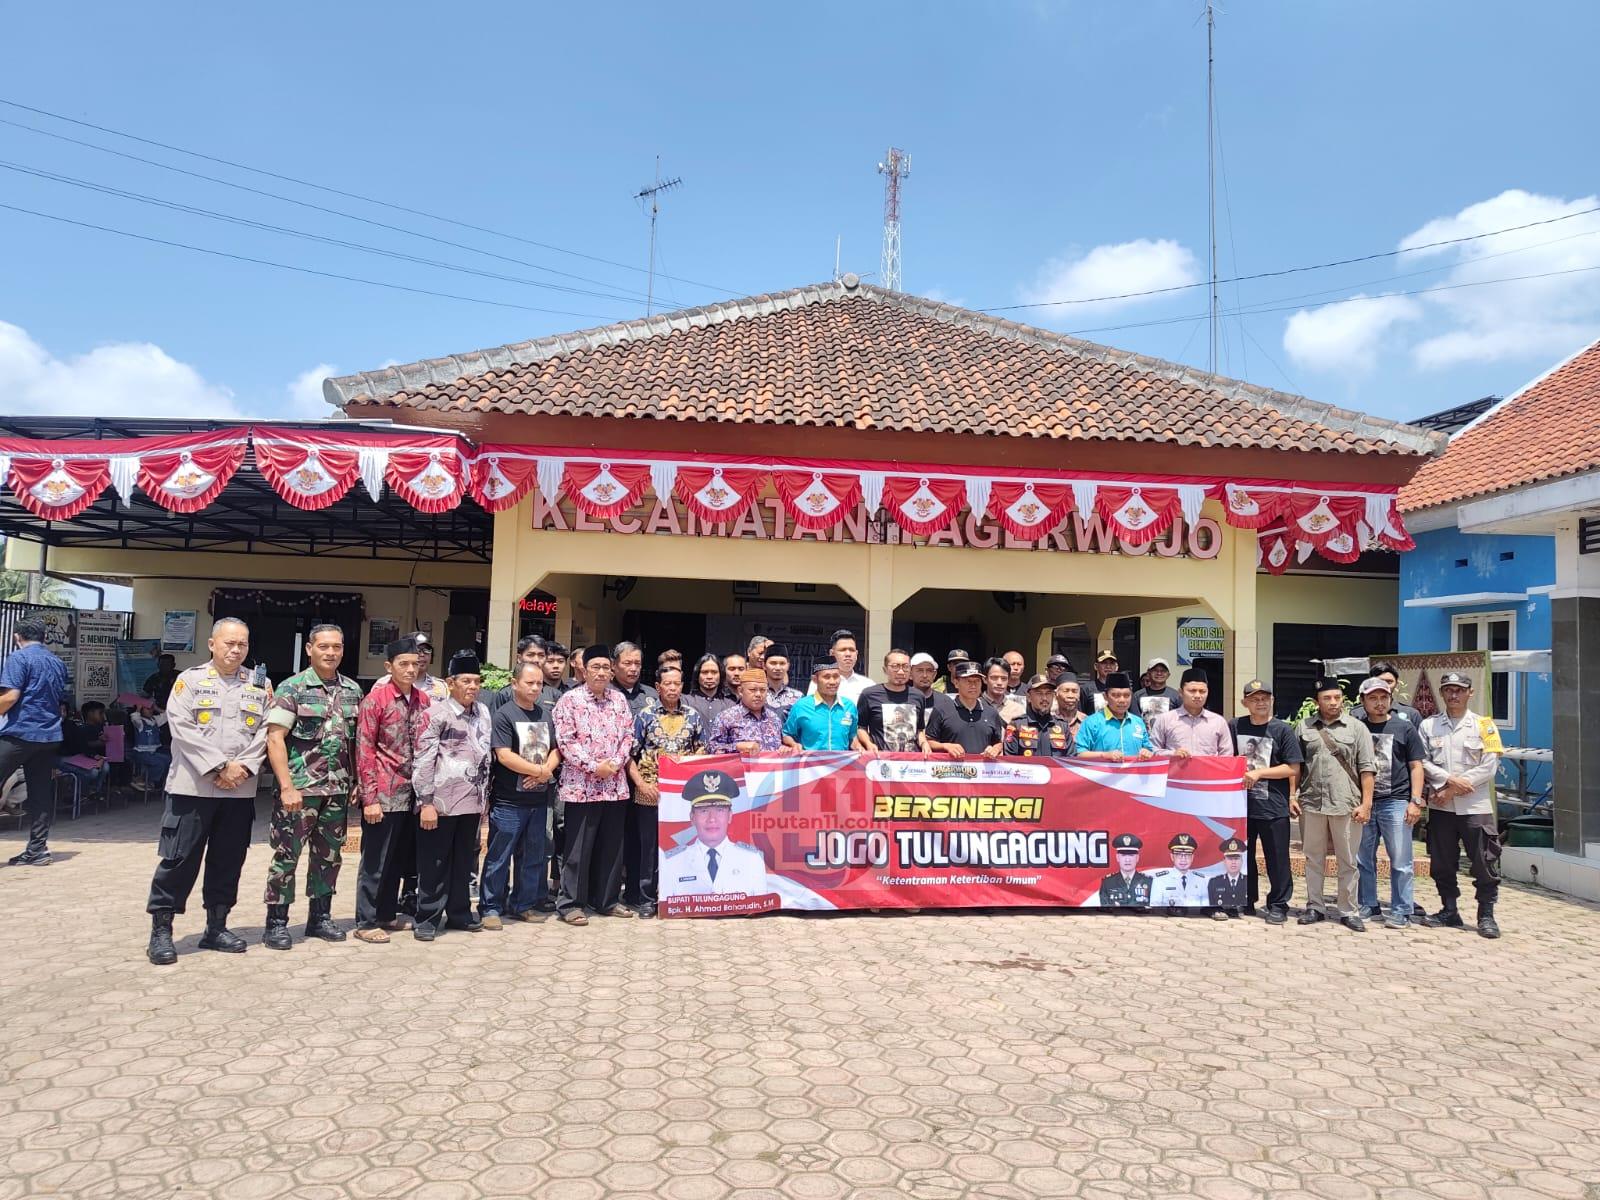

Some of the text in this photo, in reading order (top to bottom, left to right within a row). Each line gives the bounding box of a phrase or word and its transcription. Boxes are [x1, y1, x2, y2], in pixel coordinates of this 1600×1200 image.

[1180, 627, 1208, 638] POSKO
[80, 634, 85, 643] 5
[874, 796, 1044, 821] BERSINERGI
[806, 831, 1109, 867] JOGO TULUNGAGUNG
[950, 875, 1002, 885] Ketertiban
[667, 893, 746, 904] BUPATI TULUNGAGUNG
